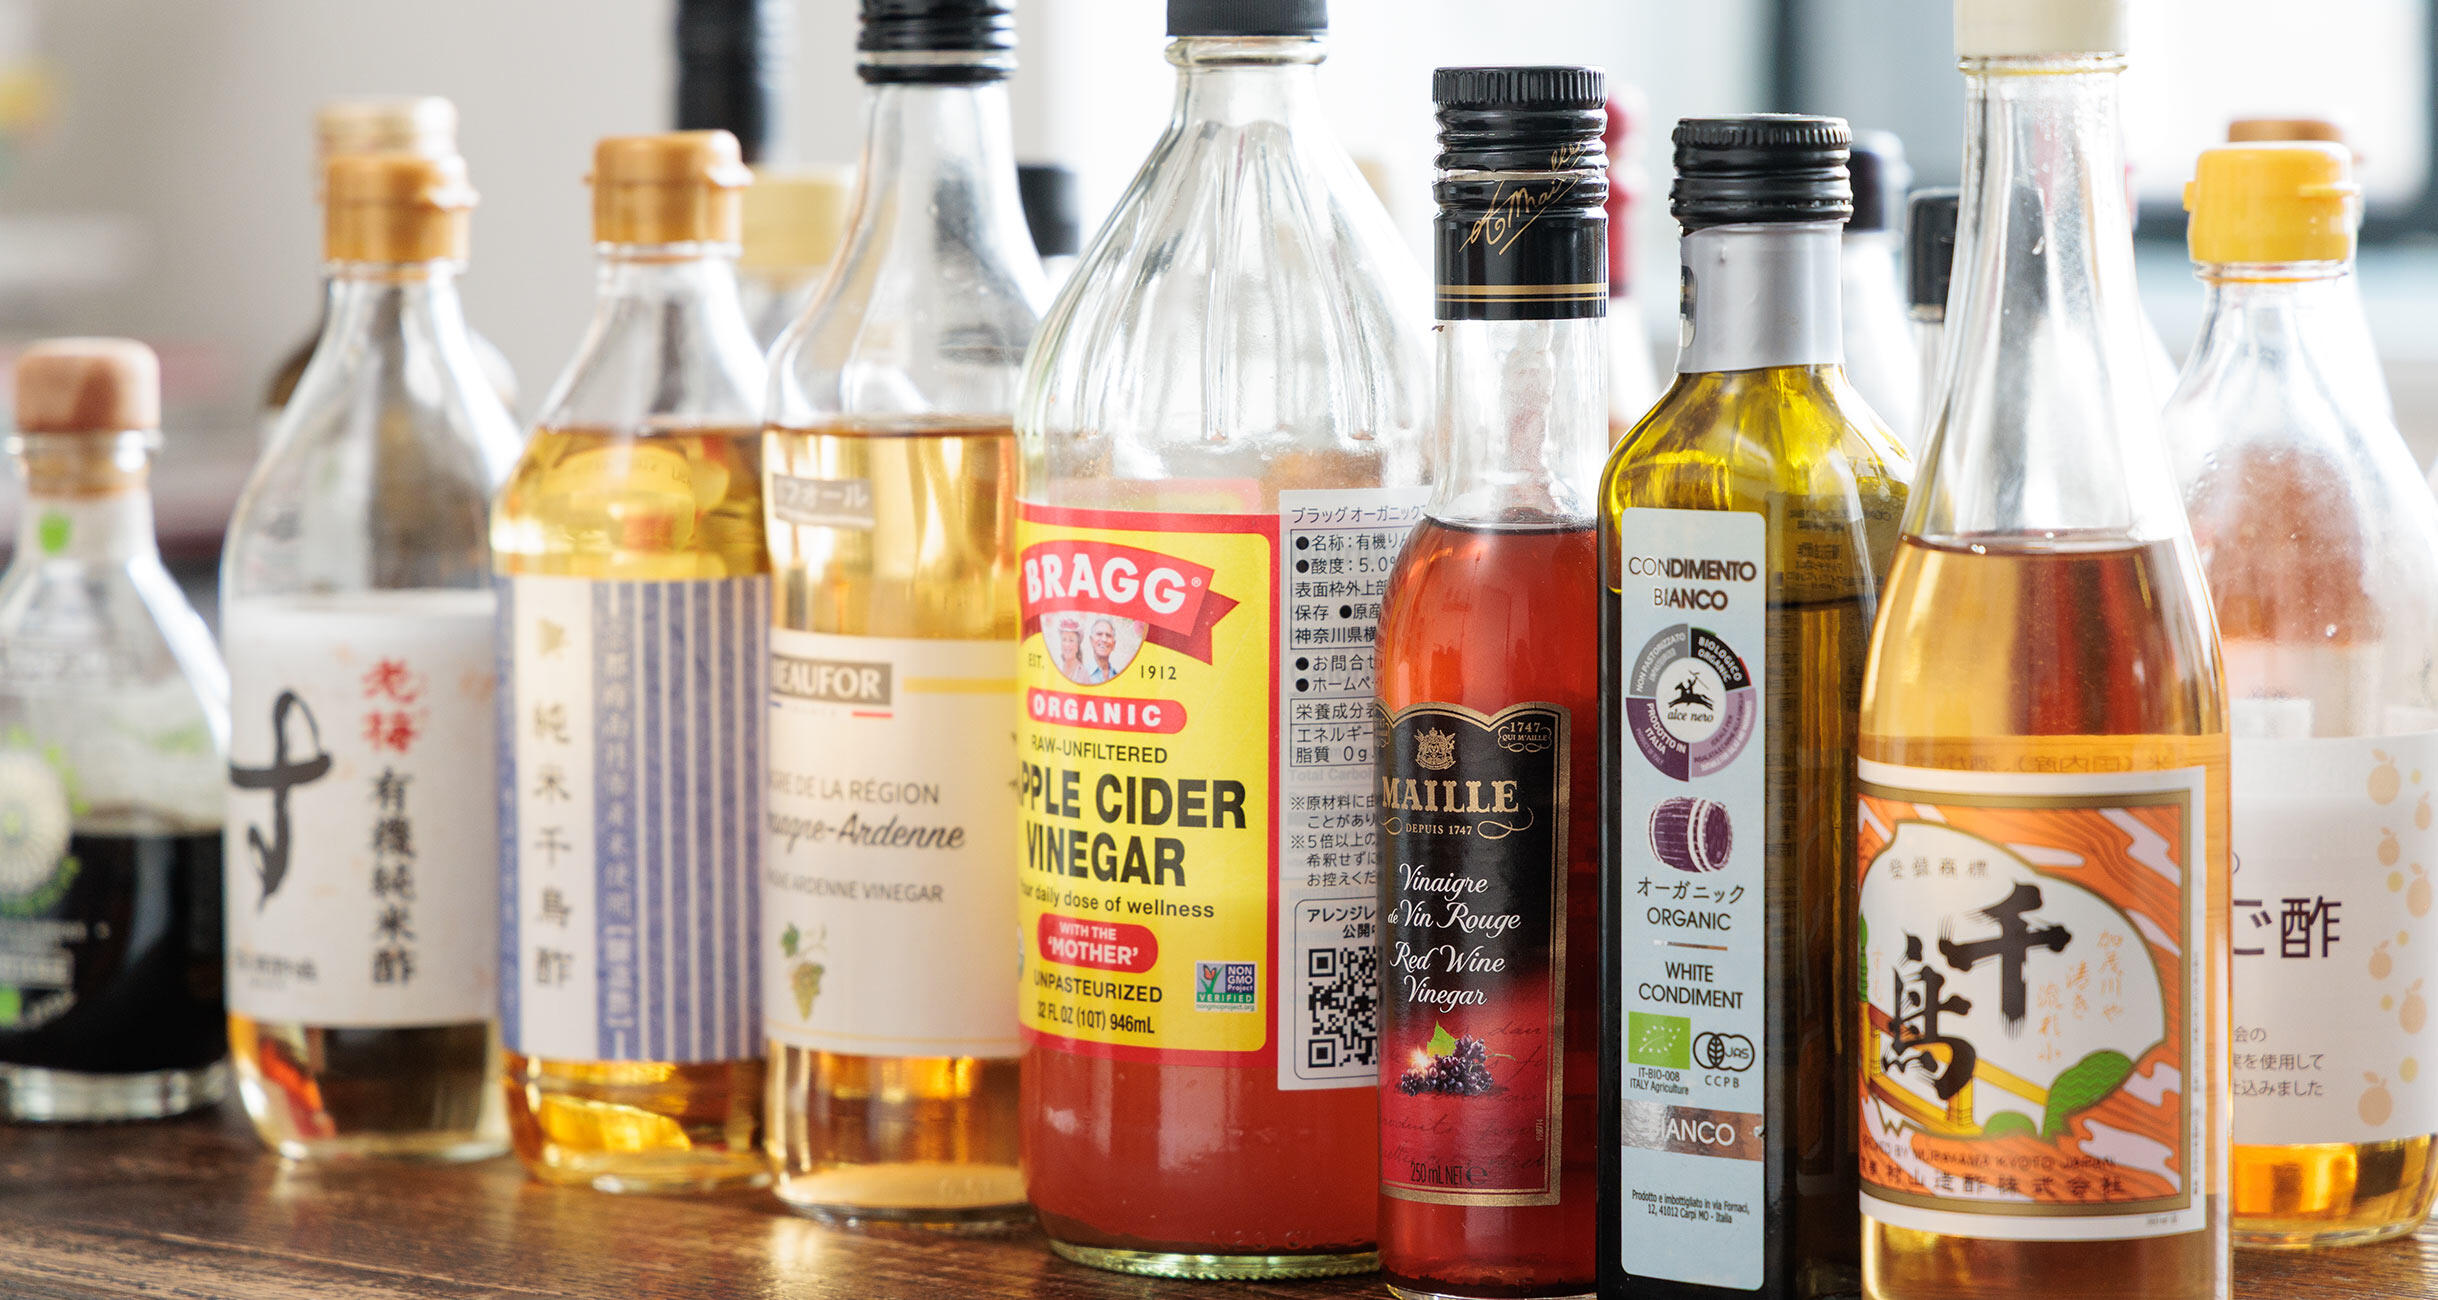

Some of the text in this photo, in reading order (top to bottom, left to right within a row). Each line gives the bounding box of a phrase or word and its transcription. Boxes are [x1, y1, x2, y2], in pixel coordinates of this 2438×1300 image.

[1291, 504, 1427, 524] ブラッグ オーガニック
[1628, 556, 1757, 583] CONDIMENTO
[1654, 588, 1729, 611] BIANCO
[1295, 604, 1329, 621] 保存
[1697, 648, 1732, 683] ORGANIC
[1698, 636, 1743, 682] BIOLOGICO
[1140, 664, 1177, 680] 1912
[1312, 675, 1374, 692] ホームペ
[1032, 694, 1162, 728] ORGANIC
[1502, 734, 1516, 742] QUI
[1510, 721, 1541, 733] 1747
[1646, 703, 1679, 749] PRODOTTO
[1644, 727, 1667, 755] ITALIA
[1295, 746, 1330, 764] 脂質
[821, 779, 843, 800] LA
[849, 777, 941, 805] RÉGION
[1017, 760, 1247, 829] PPLE CIDER
[1382, 776, 1519, 813] MAILLE
[1405, 823, 1473, 836] DEPUIS 1747
[1026, 820, 1187, 887] VINEGAR
[862, 882, 944, 903] VINEGAR
[1399, 863, 1489, 902] Vinaigre
[1636, 875, 1745, 905] オーガニック
[1034, 884, 1060, 908] daily
[1064, 891, 1099, 912] dose
[1105, 896, 1121, 913] of
[1127, 899, 1215, 918] wellness
[1059, 921, 1117, 941] WITH THE
[1387, 899, 1522, 939] de Vin Rouge
[1646, 907, 1732, 931] ORGANIC
[1389, 941, 1506, 974] Red Wine
[1227, 975, 1253, 985] GMO
[1228, 966, 1252, 976] NON
[1665, 961, 1714, 983] WHITE
[1034, 969, 1163, 1004] UNPASTEURIZED
[1199, 993, 1253, 1003] VERIFIED
[1227, 985, 1253, 993] Project
[1403, 975, 1489, 1013] Vinegar
[1638, 983, 1744, 1010] CONDIMENT
[1060, 1005, 1073, 1025] OZ
[1076, 1006, 1106, 1031] (1QT)
[1109, 1013, 1155, 1034] 946mL
[1630, 1078, 1689, 1095] ITALY Agriculture
[1638, 1067, 1680, 1082] IT-BIO-008
[1410, 1161, 1427, 1184] 250
[1428, 1165, 1443, 1185] mL
[1446, 1165, 1463, 1185] NET
[1632, 1189, 1658, 1203] Prodotto
[1647, 1203, 1658, 1216] 12,
[1659, 1205, 1679, 1218] 41012
[1679, 1207, 1697, 1221] Carpi
[1698, 1210, 1709, 1221] MO
